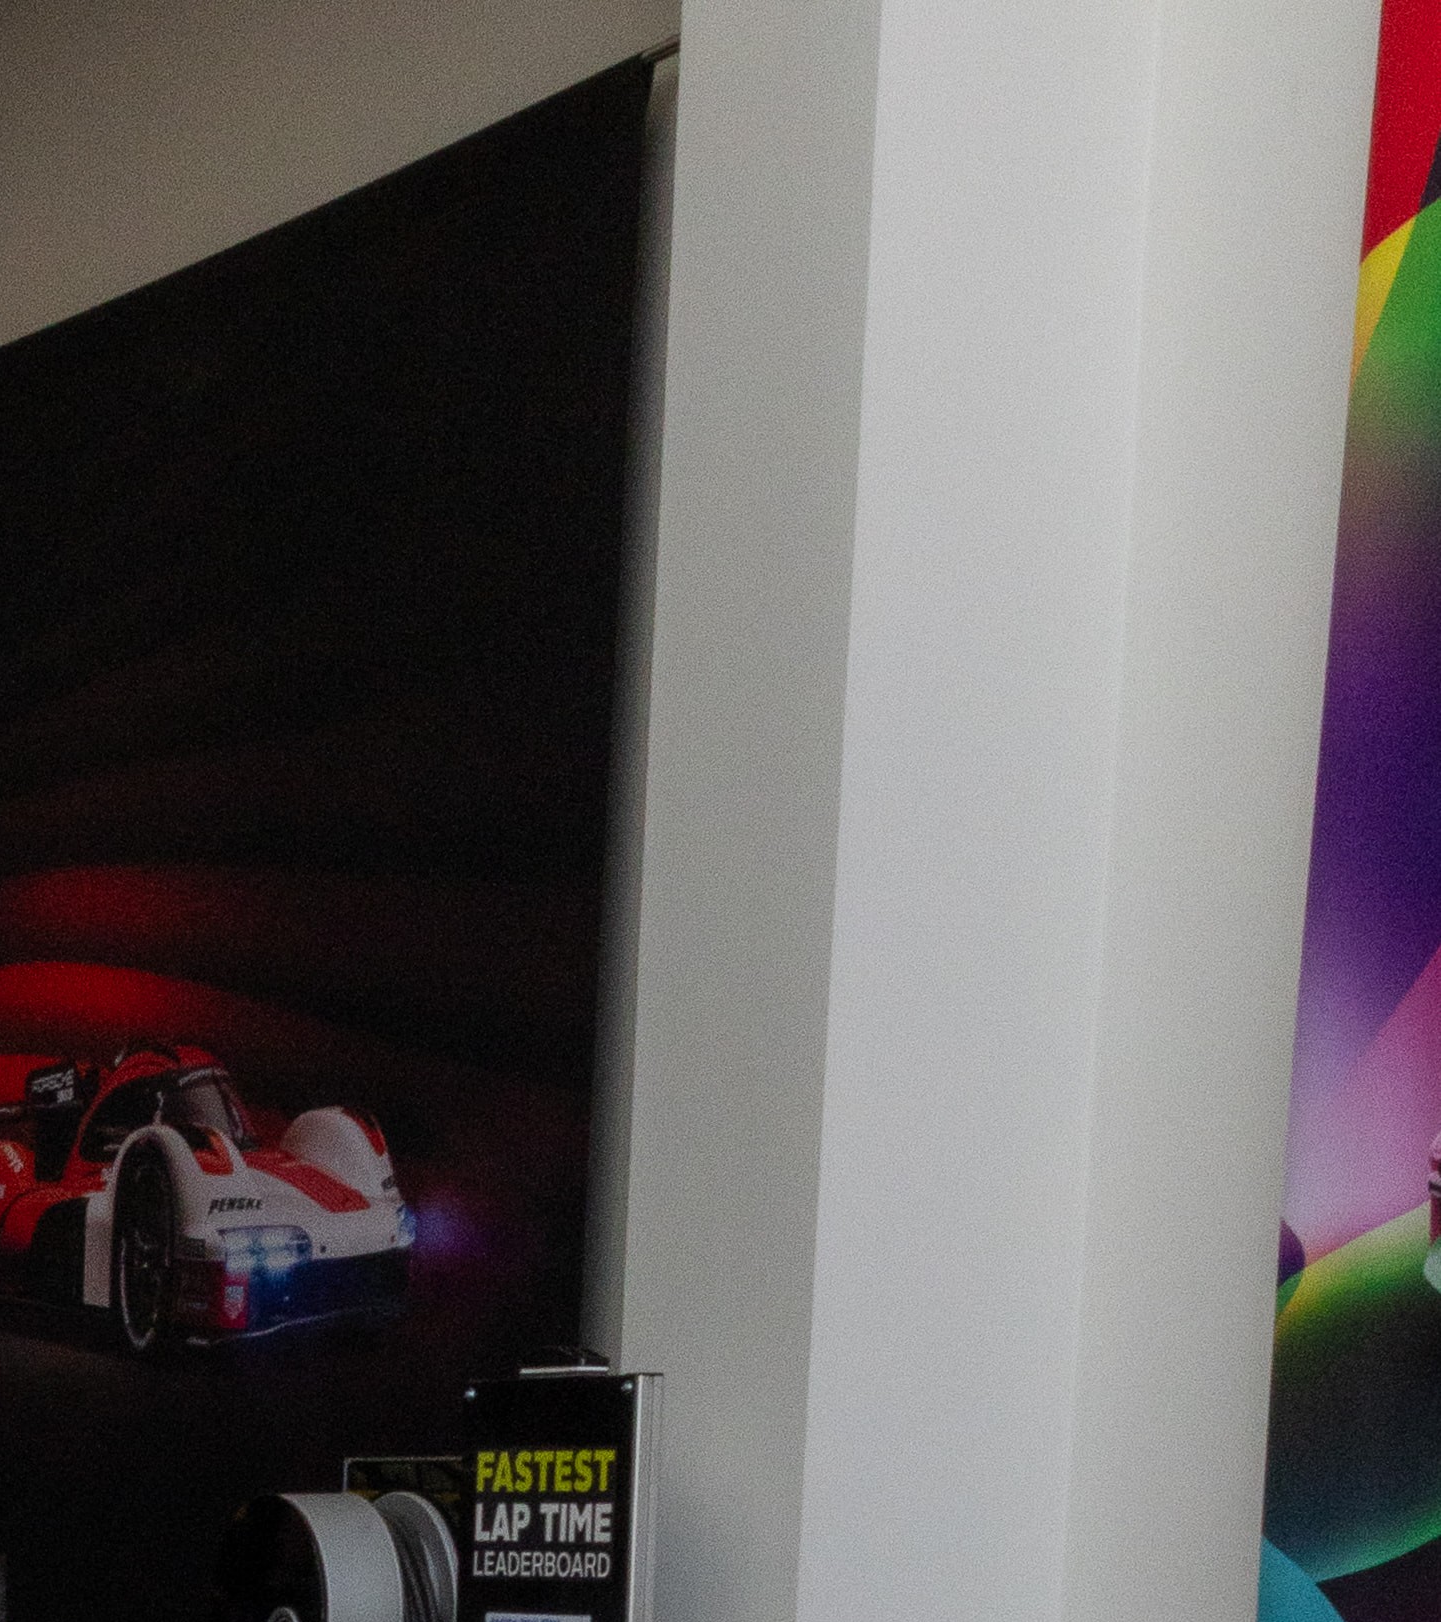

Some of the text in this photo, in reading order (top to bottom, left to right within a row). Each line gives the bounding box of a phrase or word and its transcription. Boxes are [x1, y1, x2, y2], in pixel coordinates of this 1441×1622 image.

[475, 1449, 616, 1493] FASTEST
[473, 1502, 613, 1544] LAP TIME
[472, 1550, 611, 1579] LEADERBOARD
